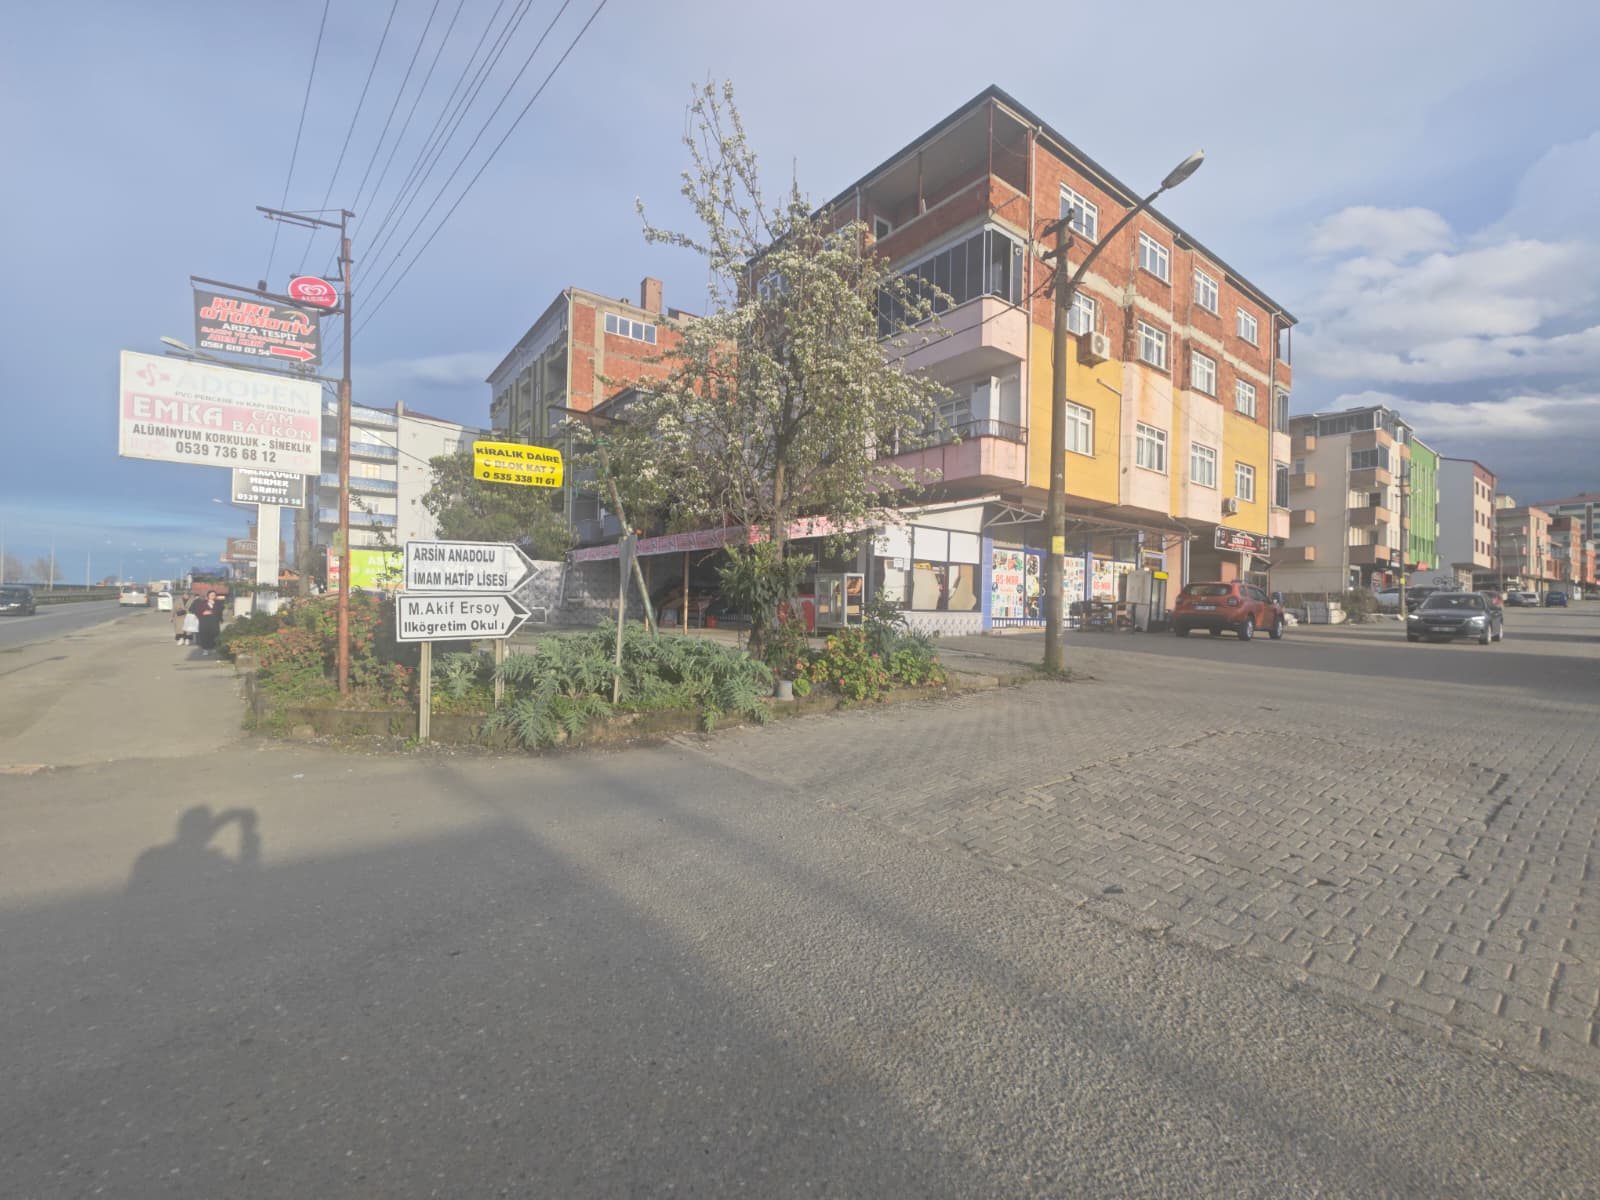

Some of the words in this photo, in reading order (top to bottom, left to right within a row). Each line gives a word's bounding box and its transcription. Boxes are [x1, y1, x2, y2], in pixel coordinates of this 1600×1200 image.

[222, 323, 258, 335] ARIZA
[261, 328, 297, 341] TESPİT
[175, 370, 311, 406] ADOPEN
[133, 395, 224, 427] EMKA
[252, 410, 293, 425] CAM
[132, 423, 202, 441] ALÜMİNYUM
[205, 432, 259, 448] KORKULUK
[269, 438, 312, 454] SİNEKLİK
[232, 420, 312, 440] BALKON
[175, 441, 209, 456] 0539
[214, 445, 238, 458] 736
[242, 448, 257, 461] 68
[262, 451, 277, 463] 12
[475, 446, 524, 459] KİRALIK
[526, 452, 560, 464] DAİRE
[494, 460, 523, 471] BLOK
[526, 464, 546, 473] KAT
[493, 472, 512, 481] 535
[515, 474, 533, 483] 338
[535, 476, 543, 484] 11
[545, 477, 555, 485] 61
[413, 545, 445, 561] ARSİN
[447, 549, 496, 563] ANADOLU
[413, 568, 441, 585] İMAM
[444, 569, 474, 586] HATİP
[476, 570, 508, 587] LİSESİ
[408, 601, 455, 616] M.Akif
[460, 601, 500, 617] Ersoy
